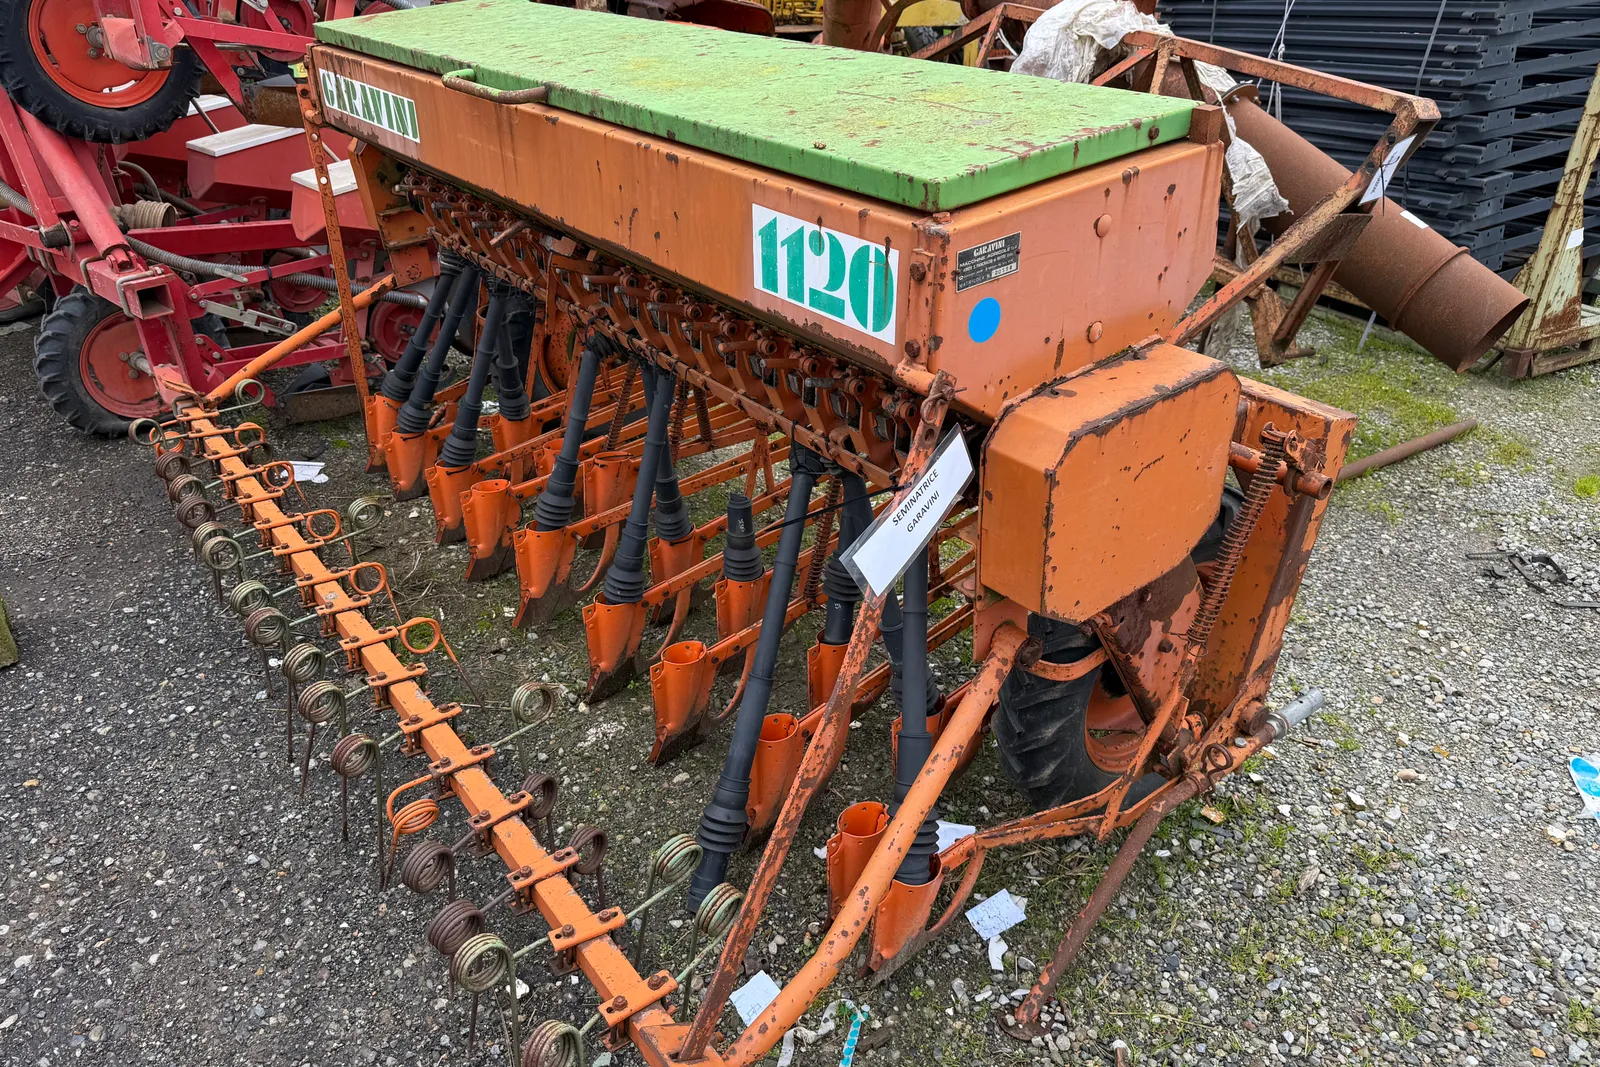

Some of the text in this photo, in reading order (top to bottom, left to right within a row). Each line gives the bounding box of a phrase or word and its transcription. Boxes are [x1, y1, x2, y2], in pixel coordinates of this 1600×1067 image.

[321, 72, 419, 140] GARAVINI
[757, 216, 895, 333] 1120
[973, 239, 1005, 257] GARAVINI
[892, 469, 940, 526] SEMINATRICE
[906, 490, 940, 533] GARAVINI
